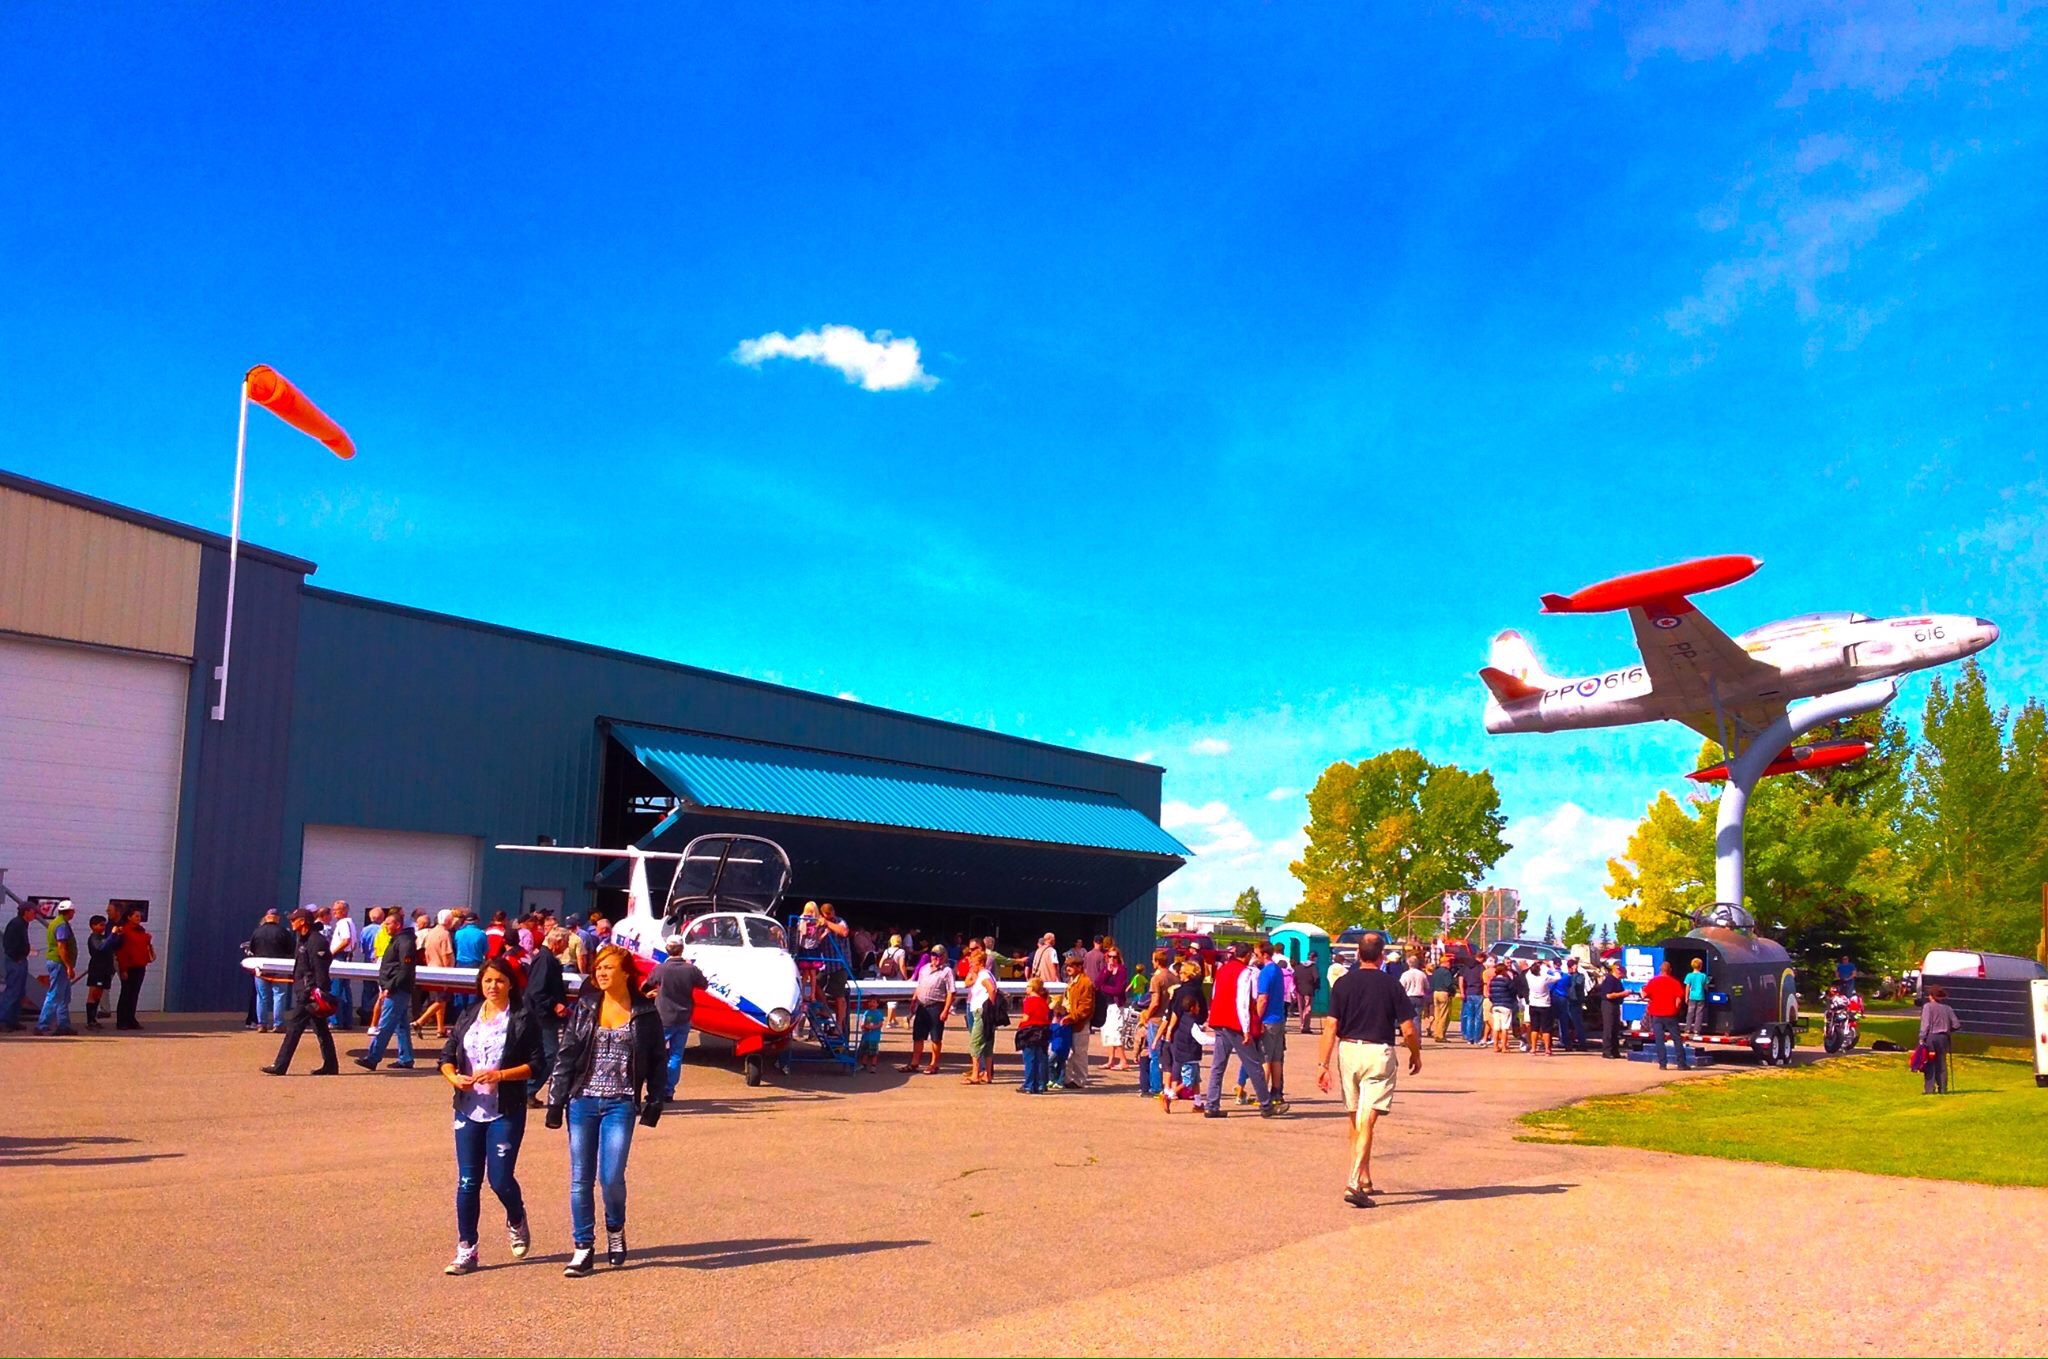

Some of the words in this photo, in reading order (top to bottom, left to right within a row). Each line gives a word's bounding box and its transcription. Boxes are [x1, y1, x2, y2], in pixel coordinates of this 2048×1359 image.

[1914, 626, 1945, 642] 616
[1544, 685, 1574, 704] PP
[1604, 668, 1643, 689] 616
